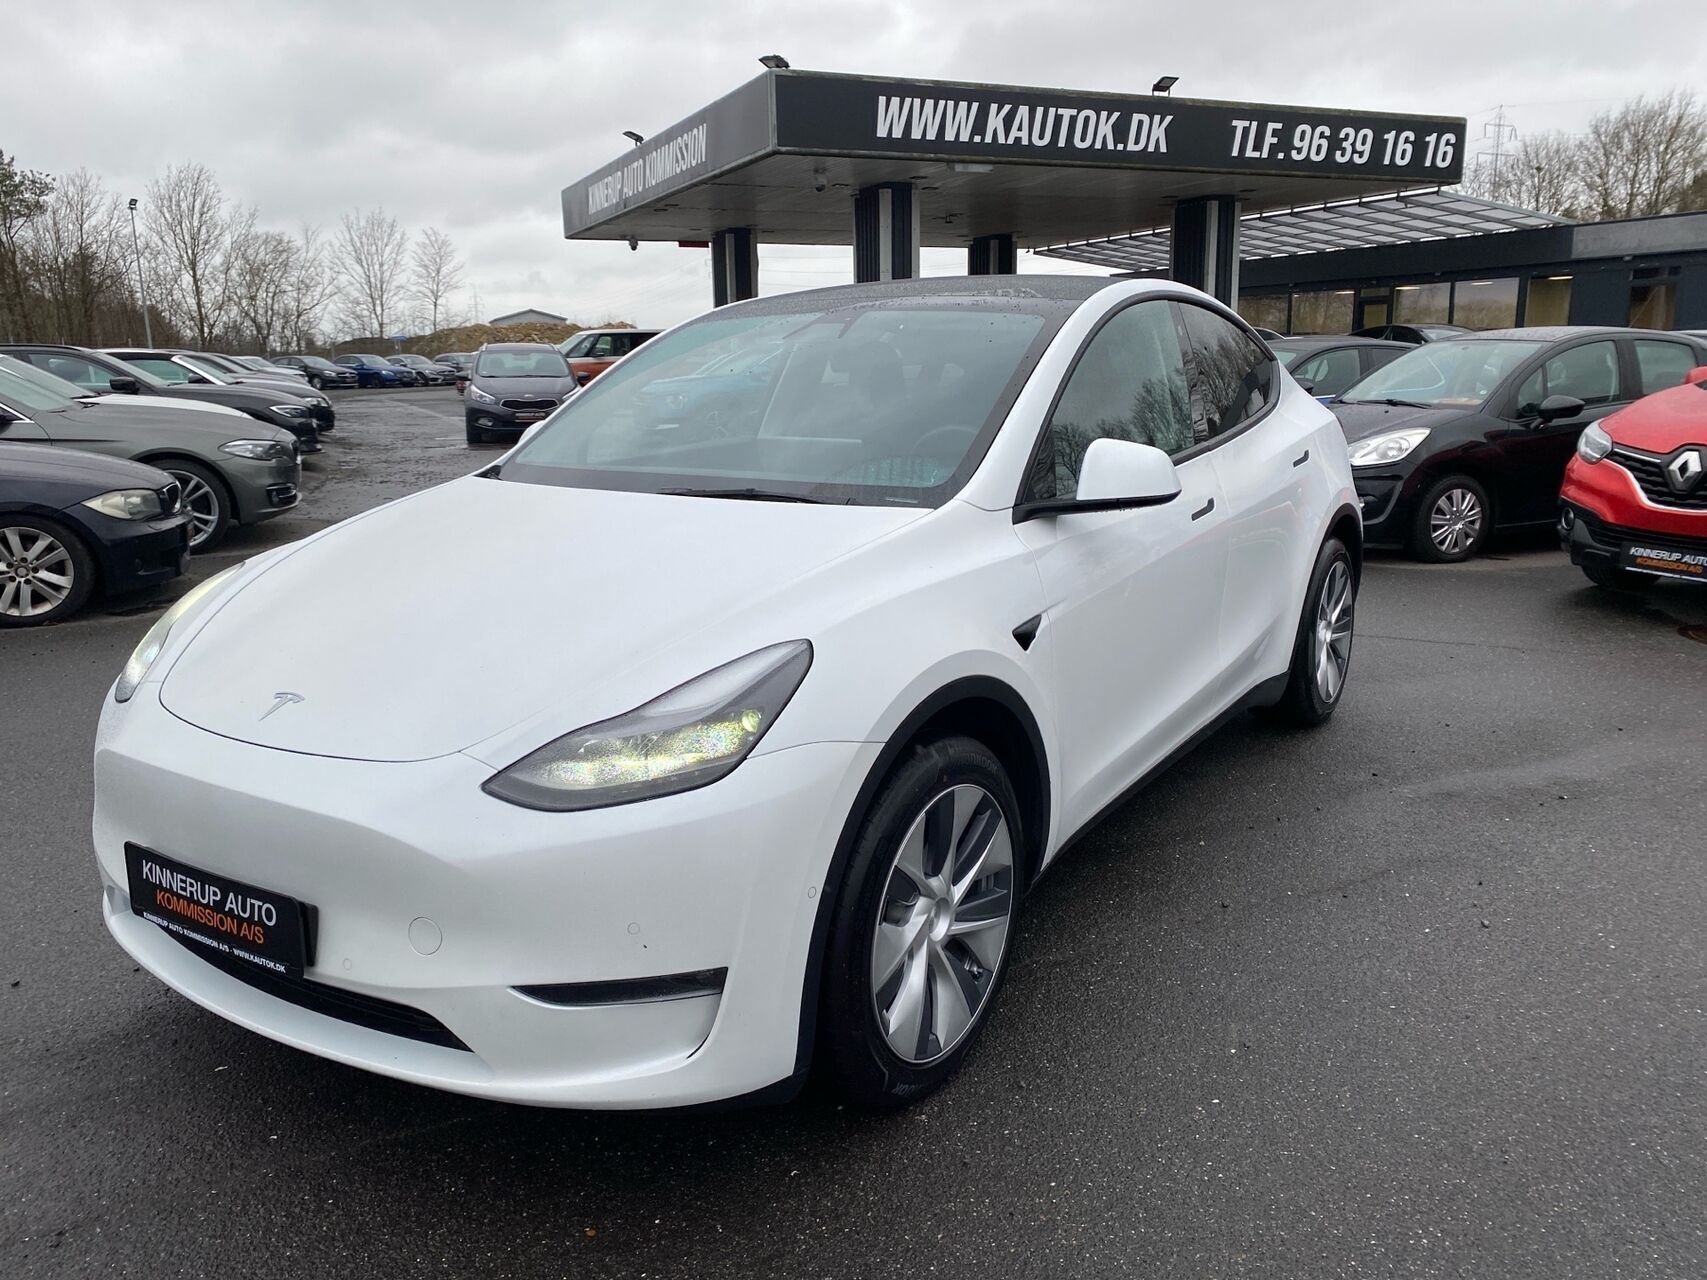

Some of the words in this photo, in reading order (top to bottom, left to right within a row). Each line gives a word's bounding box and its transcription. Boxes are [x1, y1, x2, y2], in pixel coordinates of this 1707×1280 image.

[876, 95, 1173, 153] WWW.KAUTOK.DK
[1231, 119, 1284, 160] TLF.
[1291, 123, 1331, 162] 96
[1335, 127, 1374, 165] 39
[1383, 130, 1415, 167] 16
[1424, 132, 1457, 169] 16
[588, 170, 622, 215] KINNERUP
[623, 158, 644, 199] AUTO
[645, 123, 707, 189] KOMMISSION
[1629, 546, 1682, 562] KINNERUP
[142, 859, 221, 907] KINNERUP
[224, 892, 277, 927] AUTO
[156, 889, 238, 936] KOMMISSION
[240, 921, 265, 944] A/S
[169, 923, 183, 934] AUTO
